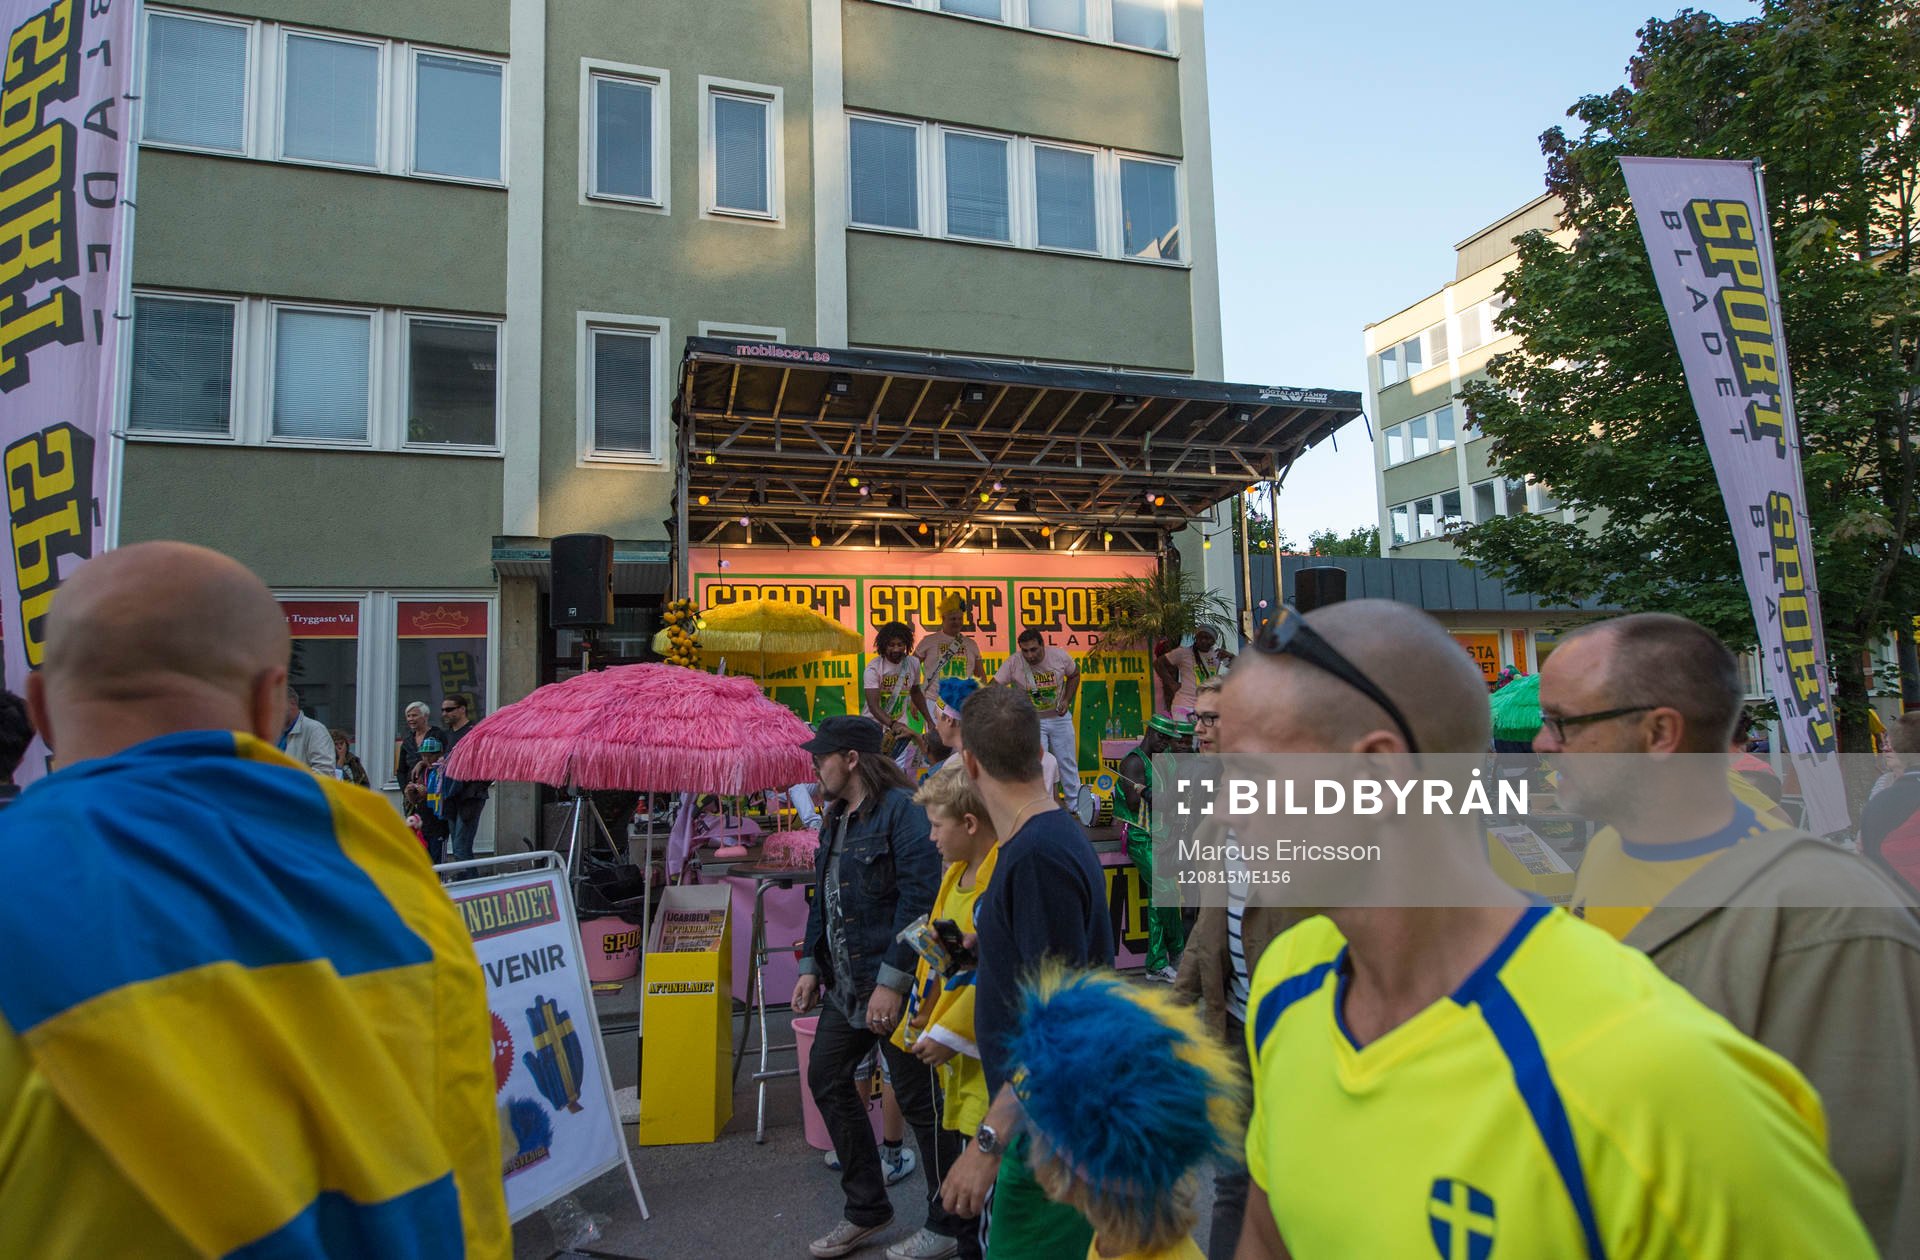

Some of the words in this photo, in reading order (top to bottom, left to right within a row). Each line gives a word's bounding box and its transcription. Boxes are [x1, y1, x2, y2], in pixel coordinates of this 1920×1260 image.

[1660, 210, 1749, 444] BLADET
[1683, 198, 1785, 459] SPORT
[291, 614, 337, 625] Tryggaste
[338, 613, 354, 623] Val
[1020, 587, 1132, 632] SPOR
[1766, 490, 1838, 763] SPORT
[1749, 505, 1818, 768] BLADET
[822, 660, 852, 679] TILL
[1103, 656, 1118, 674] VI
[1120, 656, 1145, 674] TILL
[481, 943, 567, 989] VENIR
